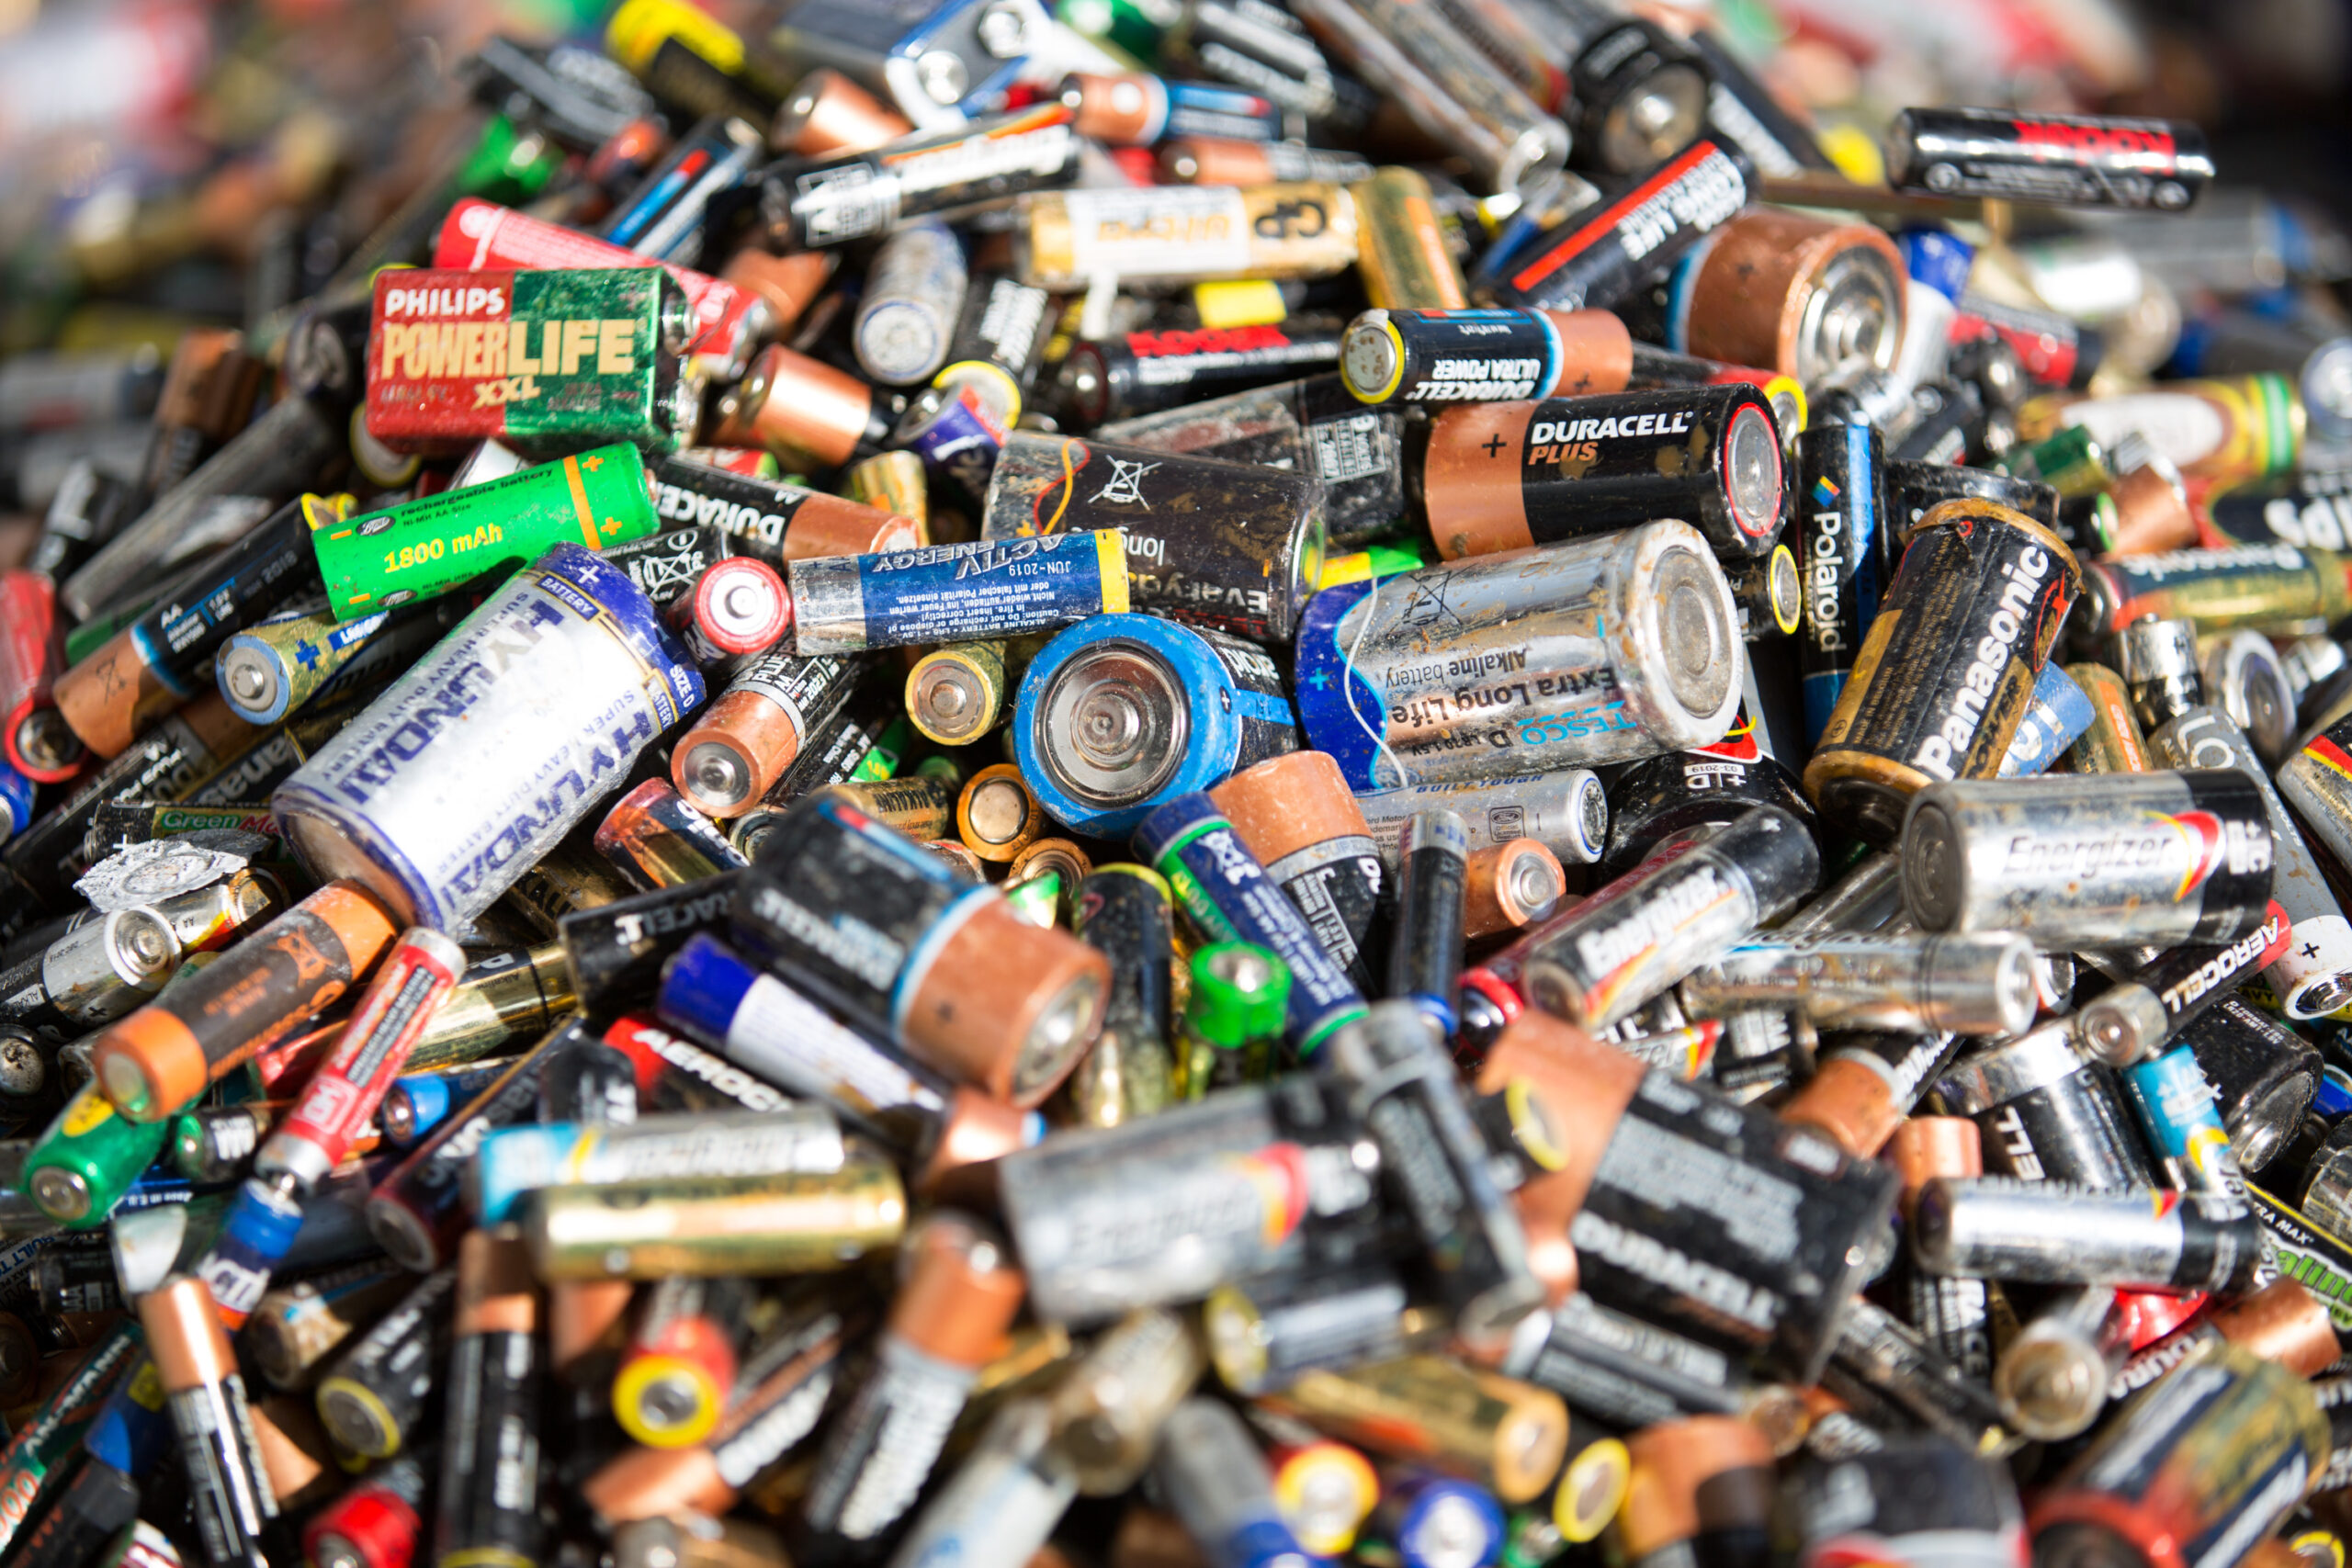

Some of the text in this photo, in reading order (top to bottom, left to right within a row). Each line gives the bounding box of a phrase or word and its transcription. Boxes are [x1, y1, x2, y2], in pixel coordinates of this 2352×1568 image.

[385, 288, 504, 317] PHILIPS
[1432, 359, 1541, 380] ULTRA POWER
[471, 375, 540, 412] XXL
[1418, 379, 1536, 400] DURACELL
[1532, 412, 1689, 446] DURACELL
[1529, 442, 1599, 466] PLUS
[400, 467, 552, 516] rechargeable battery
[384, 523, 503, 574] 1800 mAh
[873, 540, 996, 572] ENERGY
[955, 533, 1068, 581] ACTIV
[1009, 560, 1070, 577] JUN-2019
[1813, 511, 1846, 652] Polaroid
[542, 577, 595, 617] BATTERY
[889, 591, 1055, 615] Nicht wieder aufladen, ins Feuer werfen
[896, 581, 1049, 605] oder mit falscher Polarität einsetzen.
[475, 588, 531, 640] SUPER
[888, 625, 898, 634] of
[899, 620, 934, 632] dispose
[921, 604, 1025, 622] in fire. Insert correctly!
[948, 615, 989, 626] recharge
[960, 622, 1001, 633] BATTERY
[990, 614, 1005, 622] not
[1003, 617, 1046, 628] ALKALINE
[1007, 613, 1020, 621] Do
[1022, 608, 1059, 620] Caution:
[425, 637, 478, 685] HEAVY
[1384, 648, 1527, 688] Alkaline battery
[1910, 546, 2050, 783] Panasonic
[334, 597, 566, 807] HYUNDAI
[385, 683, 428, 723] DUTY
[646, 678, 673, 729] BATTERY
[669, 663, 695, 709] SIZE D
[1392, 667, 1617, 726] Extra Long Life
[582, 687, 637, 739] SUPER
[1851, 665, 1897, 746] MADE IN BELGIUM
[1487, 728, 1514, 751] D
[1519, 709, 1637, 747] TESCO
[1962, 675, 2020, 778] OWER
[1411, 740, 1442, 757] 1.5V
[1415, 770, 1544, 795] BUILT TOUGH
[1688, 774, 1703, 788] D
[1691, 763, 1739, 774] 03-2019
[439, 707, 654, 908] HYUNDAI
[1364, 813, 1408, 827] ord Motor
[2273, 803, 2306, 849] VOLTS
[429, 818, 495, 881] BATTER
[2002, 835, 2175, 882] Energizer
[2163, 914, 2280, 1011] AEROCELL
[632, 1029, 794, 1111] AEROC
[2252, 1201, 2312, 1245] TRA MAX
